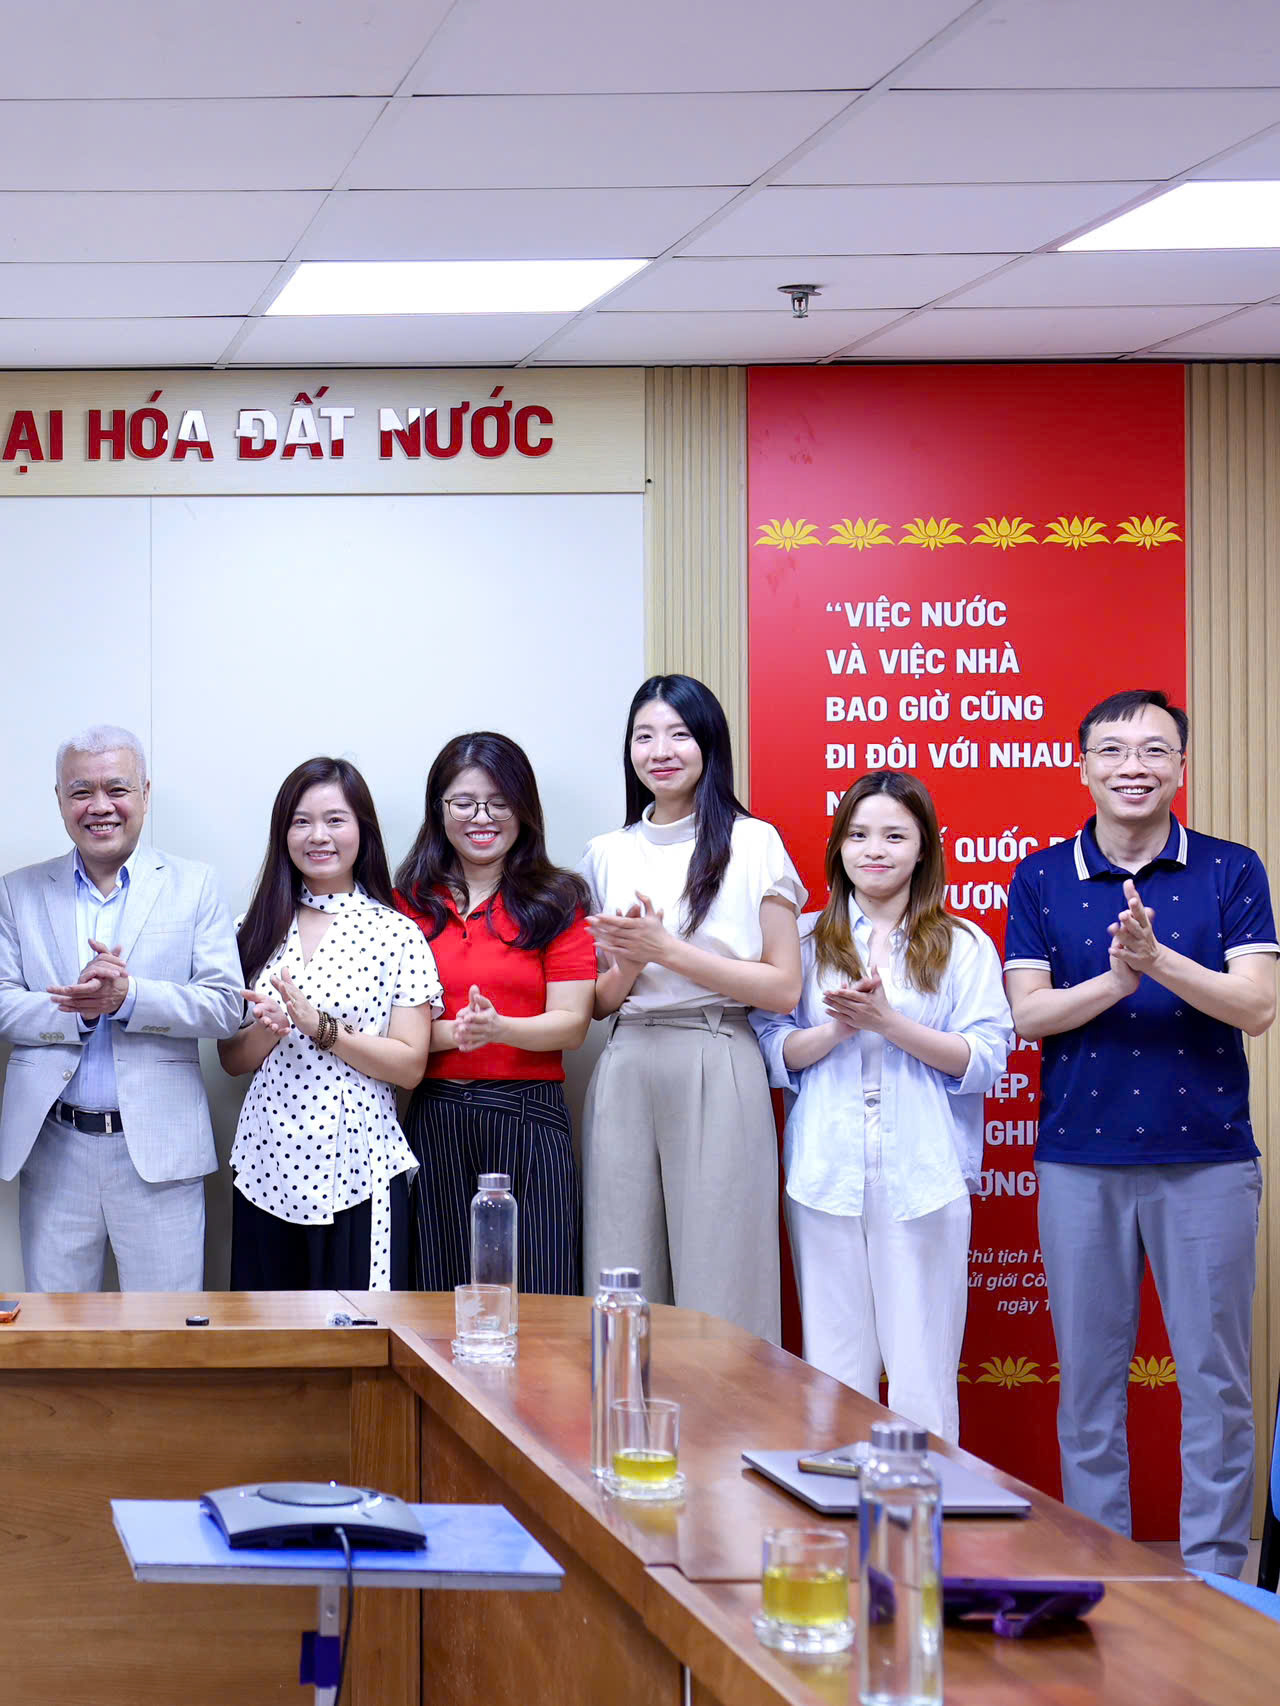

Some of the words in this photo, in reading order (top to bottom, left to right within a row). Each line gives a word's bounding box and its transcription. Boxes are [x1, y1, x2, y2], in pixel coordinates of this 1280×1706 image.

[87, 389, 215, 462] HÓA
[234, 385, 355, 460] ĐẤT
[378, 385, 554, 460] NƯỚC
[825, 594, 911, 632] “VIỆC
[921, 594, 1007, 628] NƯỚC
[825, 642, 868, 675] VÀ
[878, 641, 946, 679] VIỆC
[955, 641, 1020, 674] NHÀ
[825, 696, 888, 722] BAO
[899, 689, 951, 722] GIỜ
[960, 690, 1045, 722] CŨNG
[825, 743, 855, 769] ĐI
[865, 736, 917, 769] ĐÔI
[928, 736, 978, 769] VỚI
[954, 825, 1039, 863] QUỐC
[985, 1120, 1039, 1146] GHI
[997, 1249, 1028, 1266] tịch
[968, 1271, 983, 1288] ửi
[986, 1273, 1018, 1291] giới
[997, 1297, 1039, 1315] ngày
